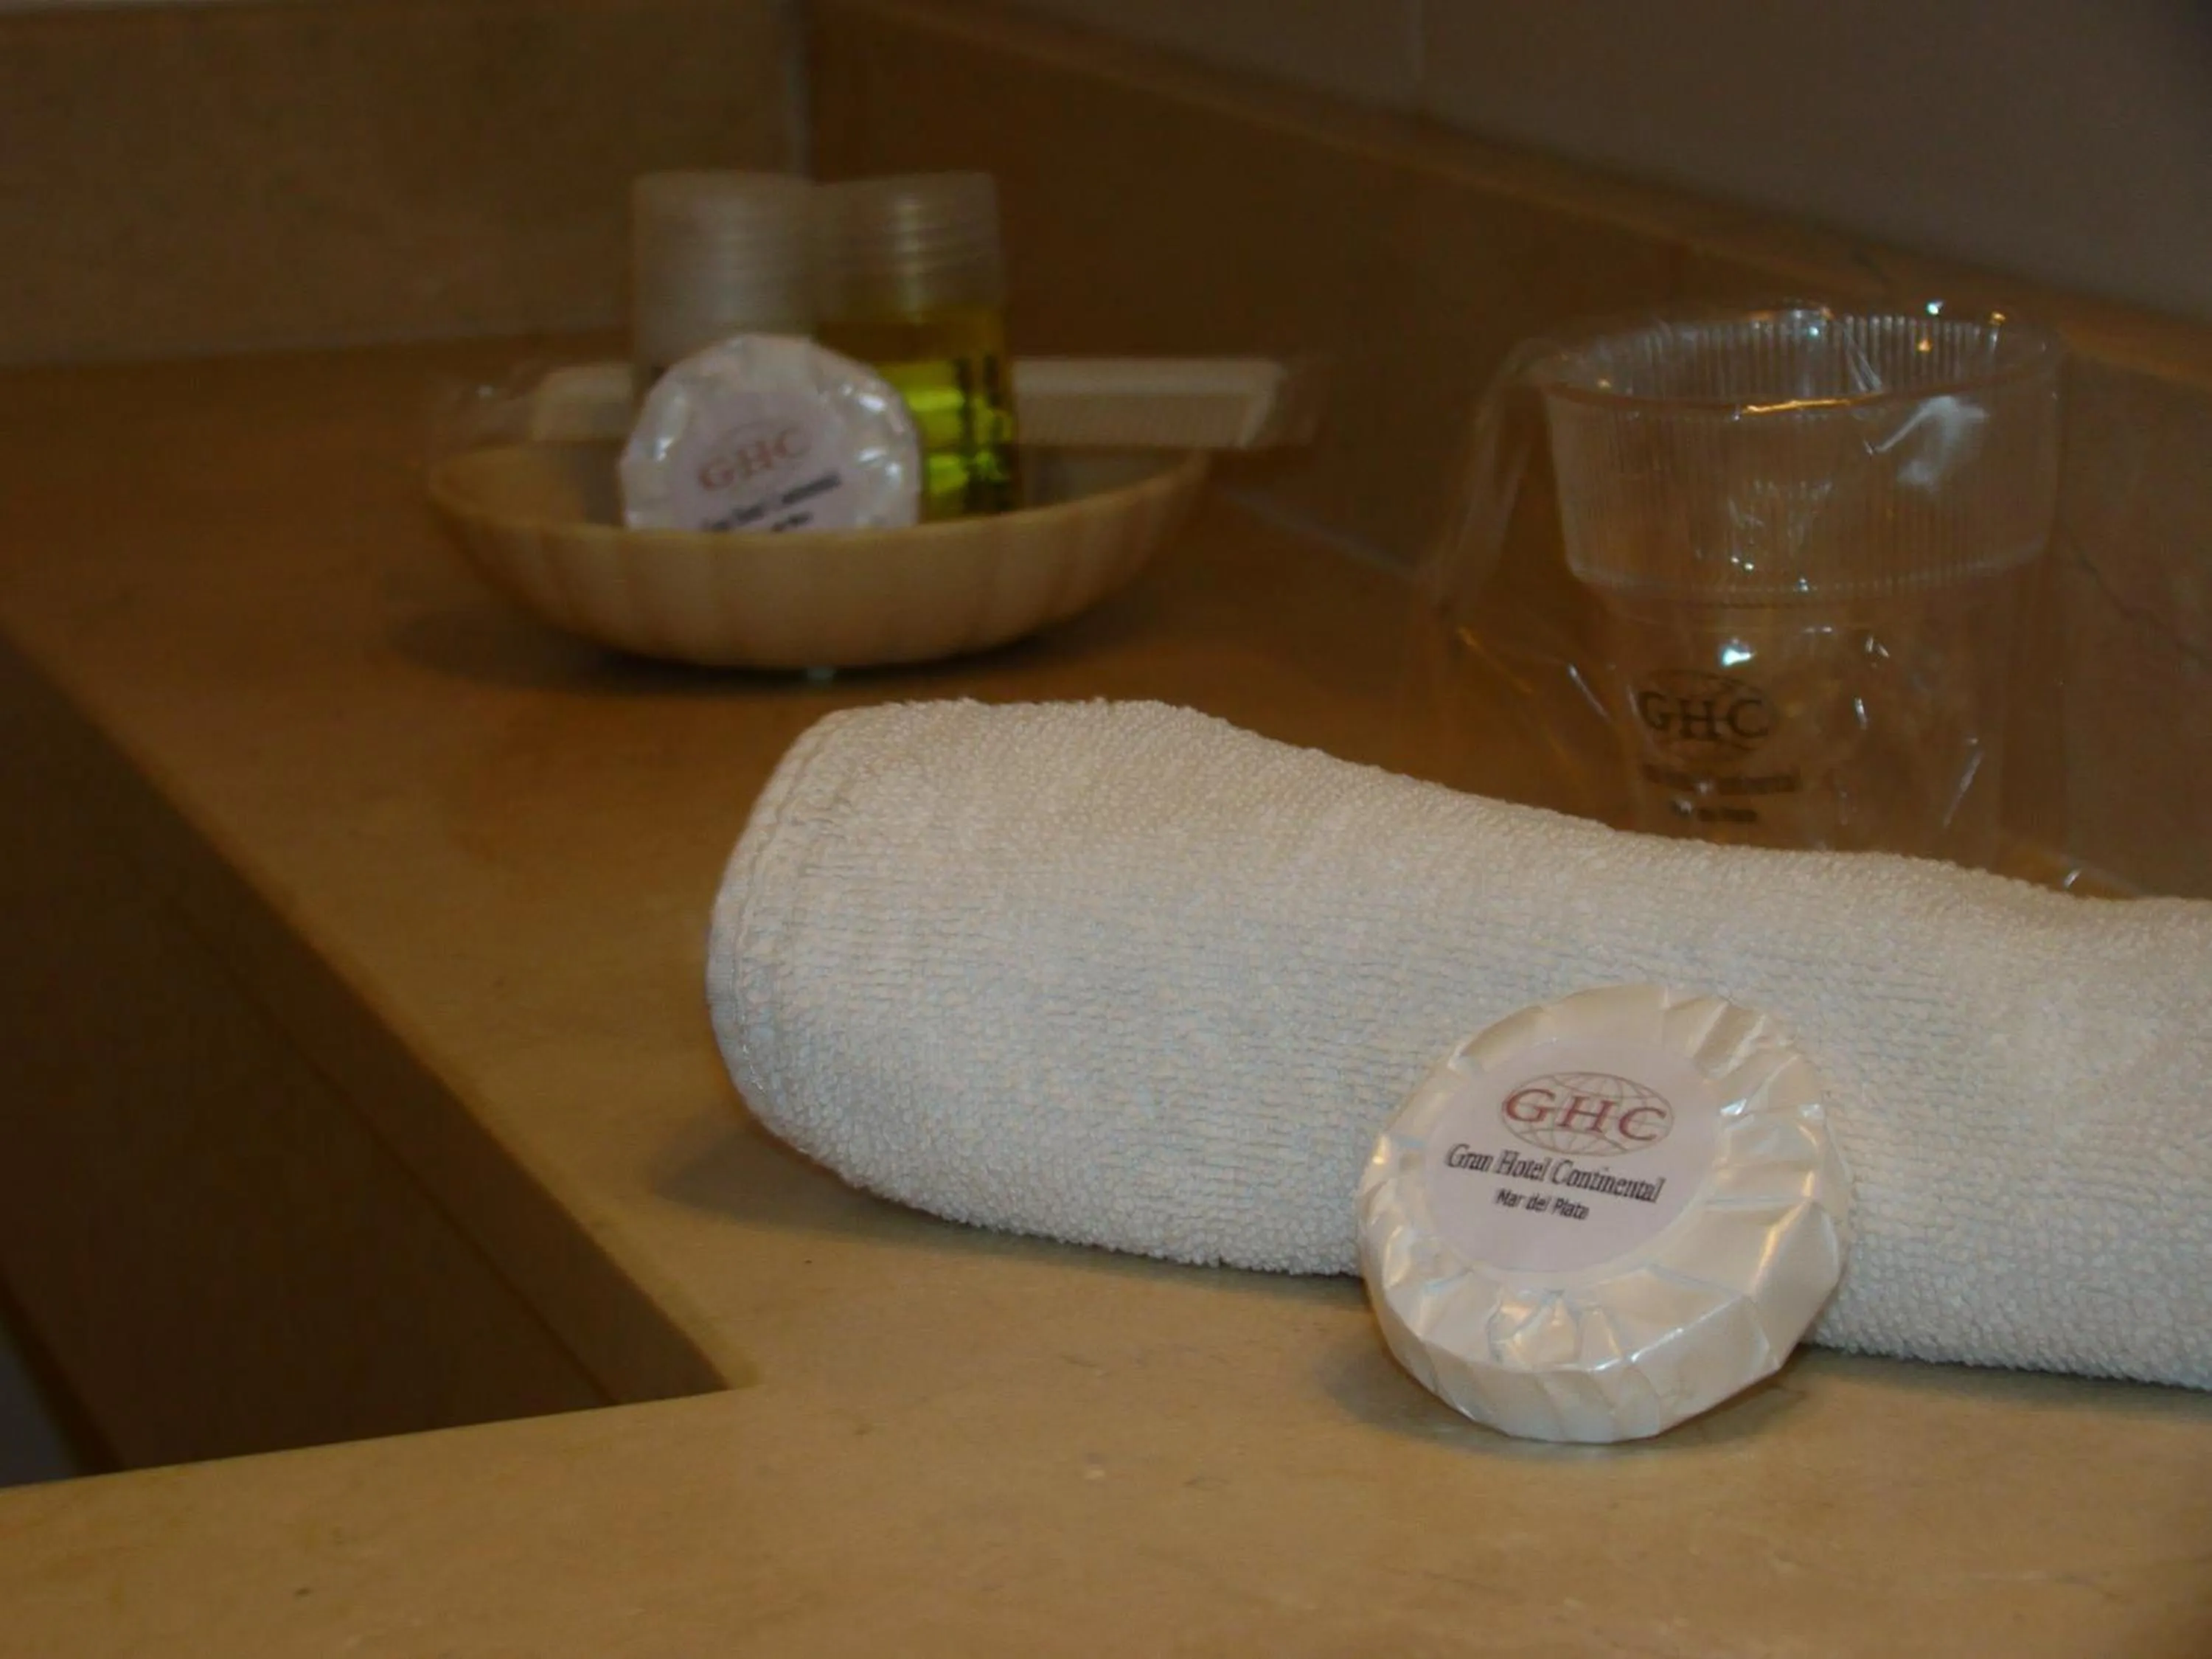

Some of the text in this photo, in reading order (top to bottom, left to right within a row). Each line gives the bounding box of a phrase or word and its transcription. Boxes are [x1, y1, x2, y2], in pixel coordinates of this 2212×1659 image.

[698, 428, 810, 492] GHC
[1637, 690, 1770, 739] GHC
[1503, 1088, 1667, 1141] GHC
[1446, 1143, 1666, 1203] Gran Hotel Continental
[1495, 1188, 1590, 1221] Mar del Plata
